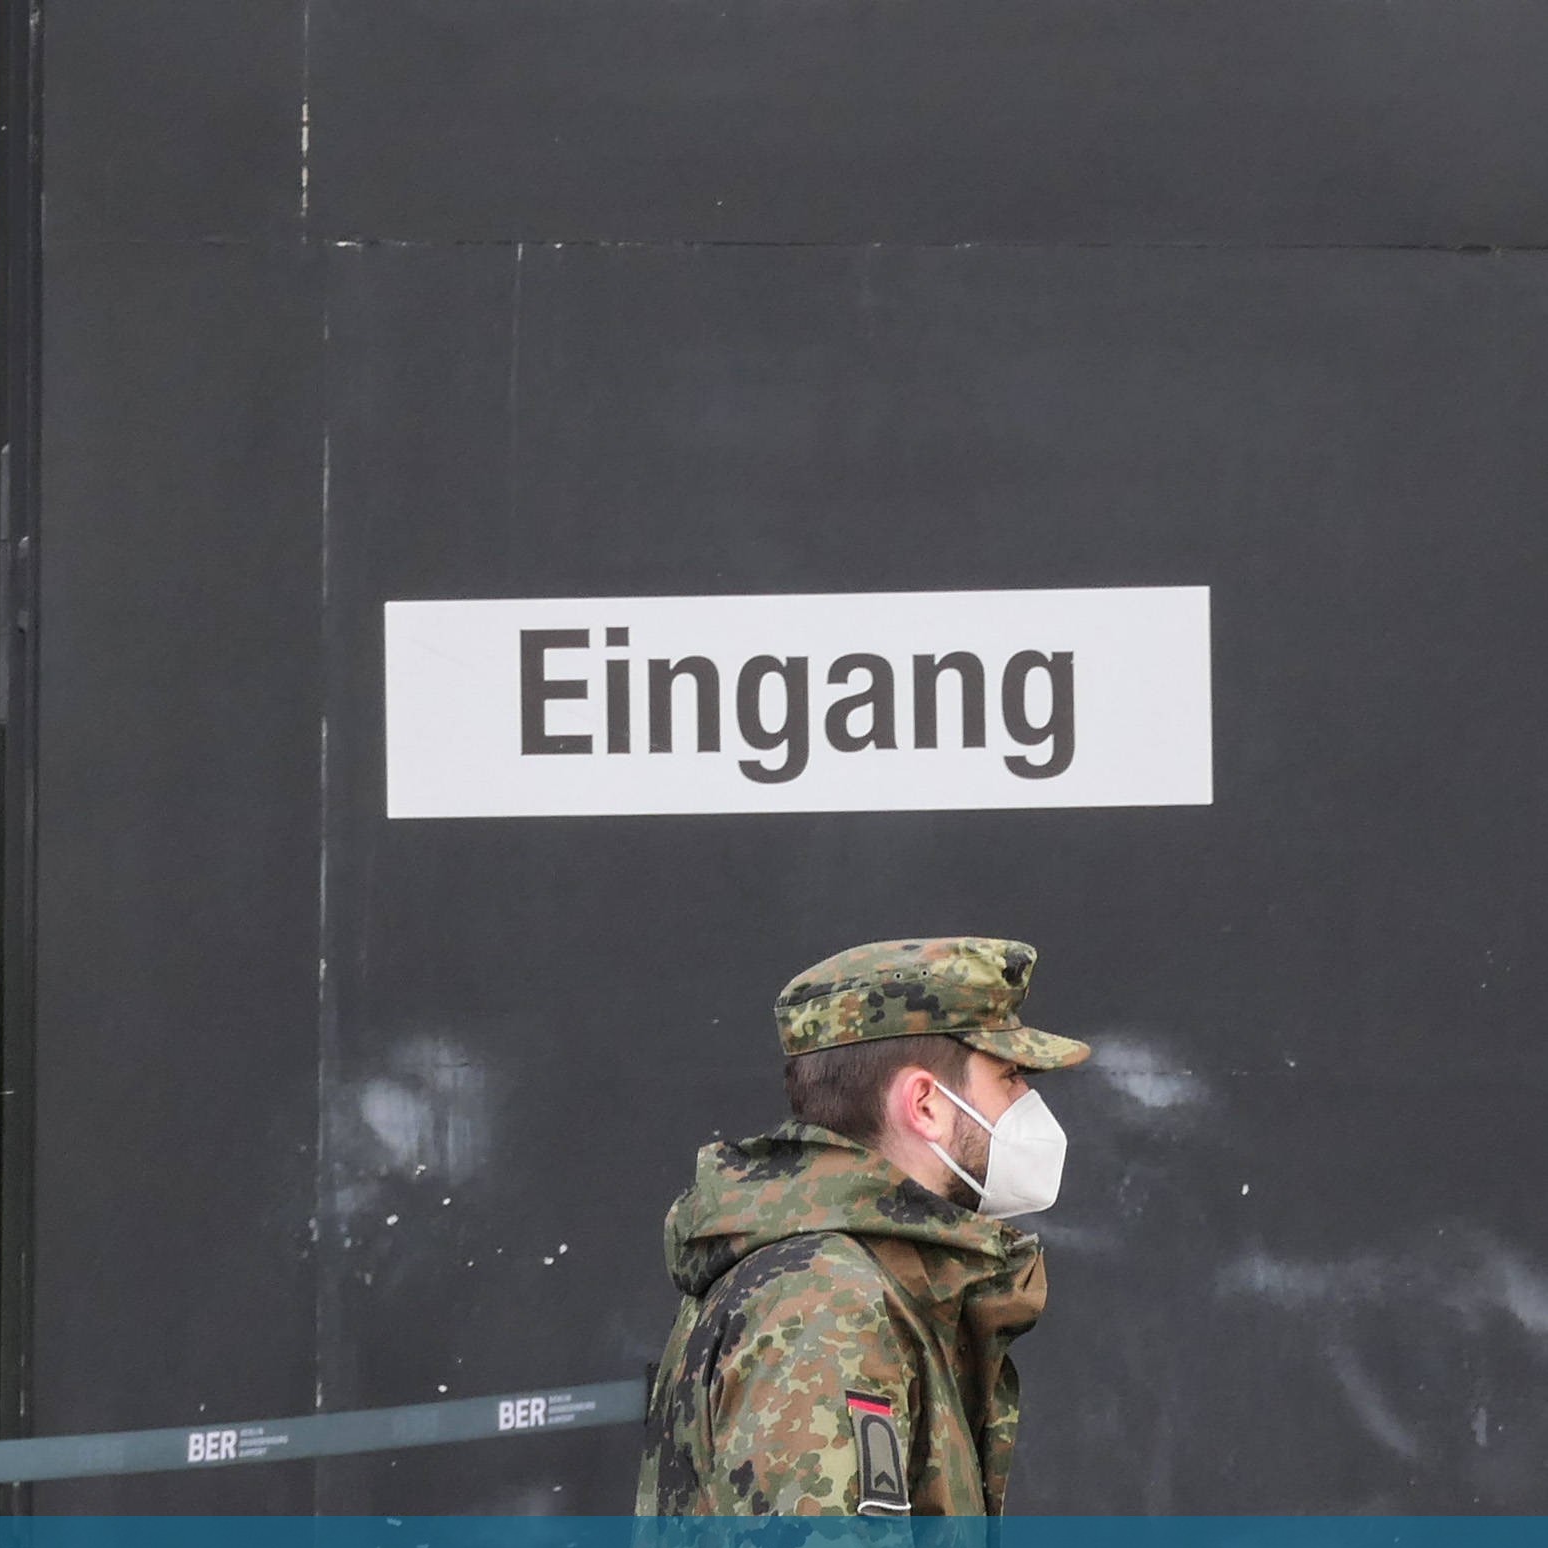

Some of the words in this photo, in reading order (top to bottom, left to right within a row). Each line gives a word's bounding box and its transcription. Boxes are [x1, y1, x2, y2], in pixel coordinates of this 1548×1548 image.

[519, 626, 1076, 785] Eingang
[498, 1397, 546, 1431] BER
[188, 1430, 237, 1463] BER
